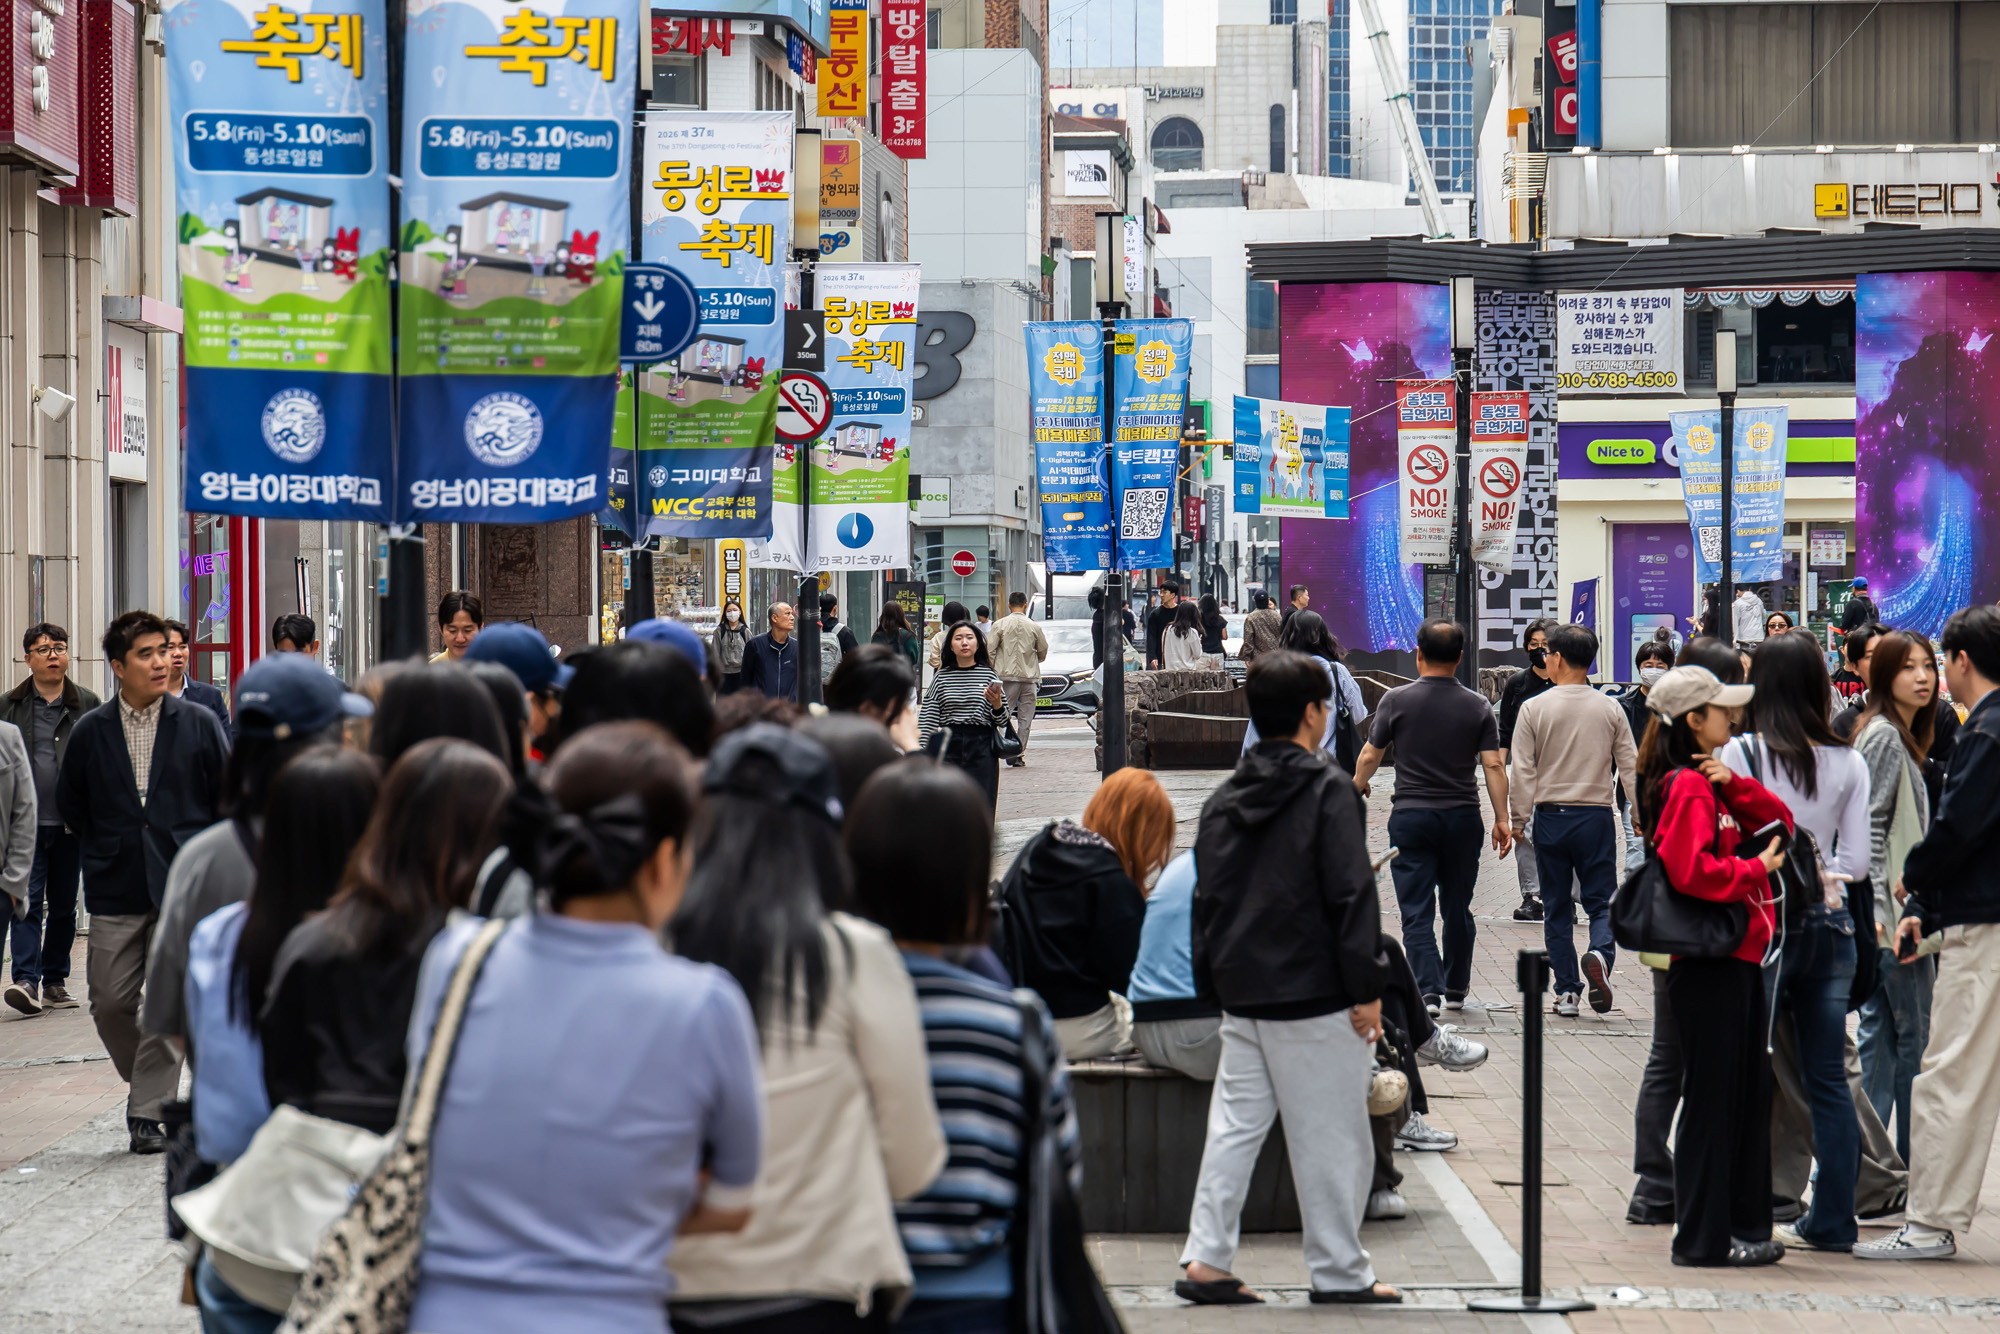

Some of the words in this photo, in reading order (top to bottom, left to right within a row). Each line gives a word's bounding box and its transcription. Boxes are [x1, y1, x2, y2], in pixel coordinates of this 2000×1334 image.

[749, 23, 758, 31] 3F
[221, 4, 363, 83] 축제
[652, 17, 736, 57] 중개사
[465, 8, 616, 87] 축제
[827, 16, 861, 110] 부동산
[888, 10, 920, 110] 방탈출
[193, 120, 367, 147] 5.8(Fri)~5.10(Sun)
[657, 131, 679, 139] 2026
[681, 130, 689, 138] 제
[691, 127, 706, 138] 37
[707, 130, 714, 138] 회
[893, 116, 915, 135] 3F
[428, 126, 614, 151] 5.8(Fri)~5.10(Sun)
[736, 142, 762, 150] Festival
[893, 138, 922, 146] 422-8788
[244, 148, 324, 168] 동성로일원
[475, 152, 562, 171] 동성로일원
[829, 167, 844, 182] 수
[652, 160, 790, 216] 동성로
[678, 219, 774, 268] 축제
[847, 273, 859, 281] 37
[1558, 297, 1588, 310] 어려운
[1592, 297, 1613, 309] 경기
[1616, 297, 1626, 309] 속
[1630, 297, 1671, 309] 부담없이
[700, 309, 741, 321] 성로일원
[823, 297, 917, 336] 동성로
[1575, 312, 1616, 325] 장사하실
[1620, 313, 1629, 324] 수
[1633, 312, 1654, 325] 있게
[1583, 327, 1645, 340] 심해돈까스가
[796, 351, 817, 360] 350m
[836, 338, 905, 374] 축제
[1571, 342, 1657, 355] 도와드리겠습니다.
[1052, 365, 1077, 380] 국비
[1141, 363, 1166, 378] 국비
[1575, 360, 1608, 371] 부담없이
[1557, 371, 1678, 389] 010-6788-4500
[842, 403, 879, 412] 동성로일원
[1407, 392, 1446, 407] 동성로
[1401, 406, 1454, 422] 금연거리
[1481, 404, 1521, 420] 동성로
[1035, 427, 1103, 443] 채용예정자
[1116, 426, 1181, 442] 채용예정자
[1475, 419, 1527, 435] 금연거리
[1117, 448, 1176, 465] 부트캠프
[1598, 446, 1628, 458] Nice
[1630, 446, 1645, 458] to
[670, 466, 763, 486] 구미대학교
[1041, 475, 1069, 485] 전문가
[200, 471, 383, 506] 영남이공대학교
[410, 473, 598, 510] 영남이공대학교
[920, 491, 949, 502] rocs
[705, 496, 735, 508] 교육부
[736, 495, 757, 508] 선정
[1410, 488, 1448, 508] NO!
[651, 497, 705, 516] WCC
[736, 508, 757, 521] 대학
[1410, 509, 1447, 519] SMOKE
[1482, 501, 1517, 521] NO!
[1481, 521, 1513, 533] SMOKE
[818, 554, 893, 566] 한국가스공사
[896, 600, 921, 612] 탈출
